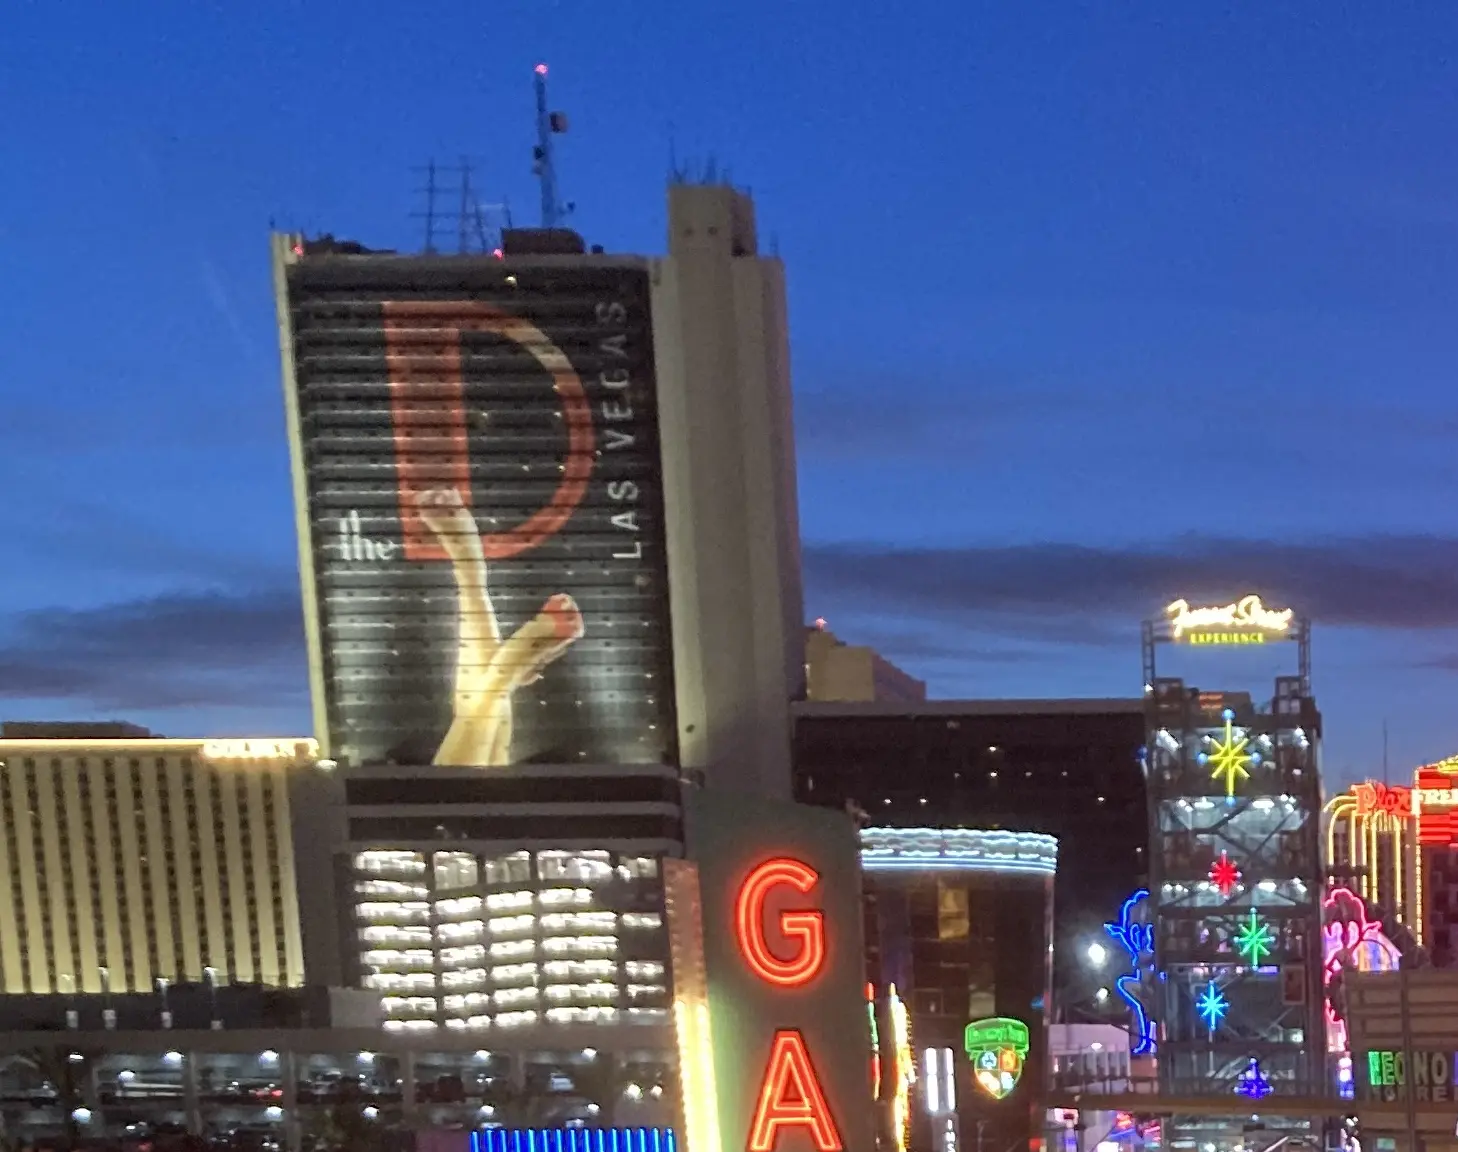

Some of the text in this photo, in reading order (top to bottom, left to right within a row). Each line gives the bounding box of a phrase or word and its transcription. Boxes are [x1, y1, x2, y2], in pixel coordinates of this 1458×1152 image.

[595, 301, 642, 560] LAS VEGAS
[1189, 632, 1265, 644] EXPERIENCE
